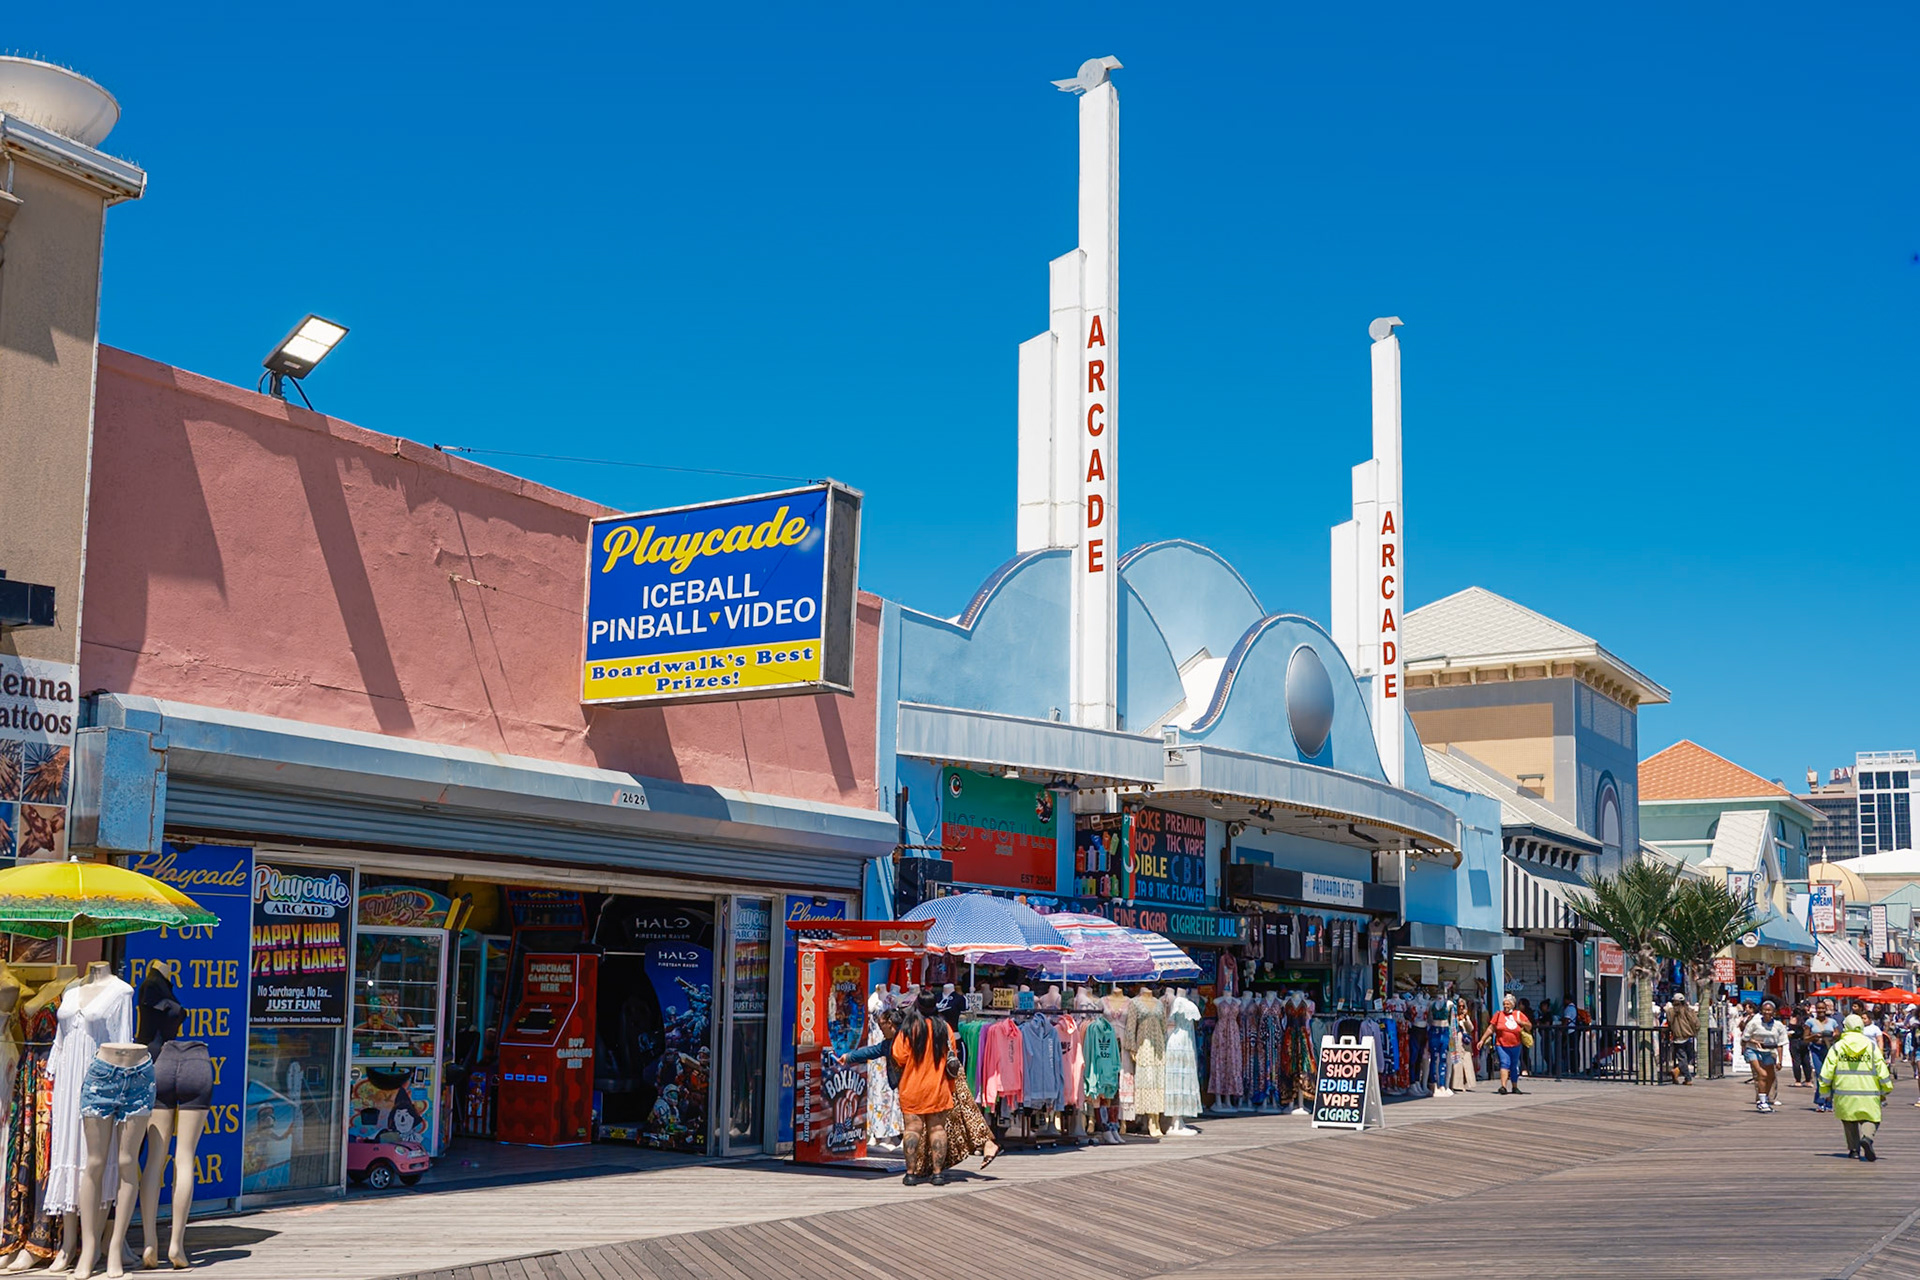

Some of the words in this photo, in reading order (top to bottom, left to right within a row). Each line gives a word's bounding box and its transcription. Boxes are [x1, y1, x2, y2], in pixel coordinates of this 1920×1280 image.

[1086, 315, 1106, 573] ARCADE
[601, 505, 810, 575] Playcade
[642, 573, 760, 610] ICEBALL
[1381, 510, 1397, 699] ARCADE
[591, 609, 708, 645] PINBALL
[724, 596, 816, 630] VIDEO
[591, 653, 746, 681] Boardwalk's
[756, 647, 814, 666] Best
[0, 663, 74, 703] enna
[655, 671, 741, 693] Prizes!
[0, 703, 72, 735] attoos
[622, 792, 646, 806] 2629
[947, 811, 975, 840] HOT
[980, 816, 1015, 844] SPOT
[1030, 824, 1054, 851] LLC
[1165, 813, 1205, 837] PREMIUM
[1135, 832, 1156, 854] HOP
[1166, 833, 1182, 853] THC
[1183, 837, 1205, 858] VAPE
[134, 852, 248, 890] Playcade
[1134, 852, 1168, 879] DIBLE
[254, 867, 349, 904] Playcade
[1156, 882, 1171, 900] THC
[1171, 884, 1205, 904] FLOWER
[1312, 877, 1341, 899] PANORAMA
[1817, 886, 1827, 896] ICE
[272, 903, 330, 917] ARCADE
[635, 917, 691, 929] HALO
[1113, 908, 1137, 929] FINE
[1139, 910, 1168, 934] CIGAR
[1171, 913, 1216, 937] CIGARETTE
[1217, 917, 1238, 938] JUUL
[252, 924, 302, 950] HAPPY
[303, 922, 342, 947] HOUR
[252, 950, 272, 977] /2
[273, 950, 300, 975] OFF
[302, 947, 347, 975] GAMES
[658, 950, 699, 960] HALO
[189, 959, 240, 989] THE
[530, 963, 571, 974] PURCHASE
[257, 986, 268, 997] No
[307, 986, 316, 998] No
[801, 952, 816, 1047] BOXER
[266, 1000, 294, 1010] JUST
[295, 1000, 321, 1011] FUN!
[1321, 1049, 1370, 1064] SMOKE
[1326, 1063, 1362, 1078] SHOP
[825, 1069, 866, 1100] BOXING
[1319, 1079, 1365, 1093] EDIBLE
[803, 1086, 811, 1120] AMERICAN
[1322, 1093, 1360, 1107] VAPE
[1317, 1107, 1360, 1122] CIGARS
[803, 1121, 811, 1142] BOXER
[826, 1126, 865, 1148] Champion
